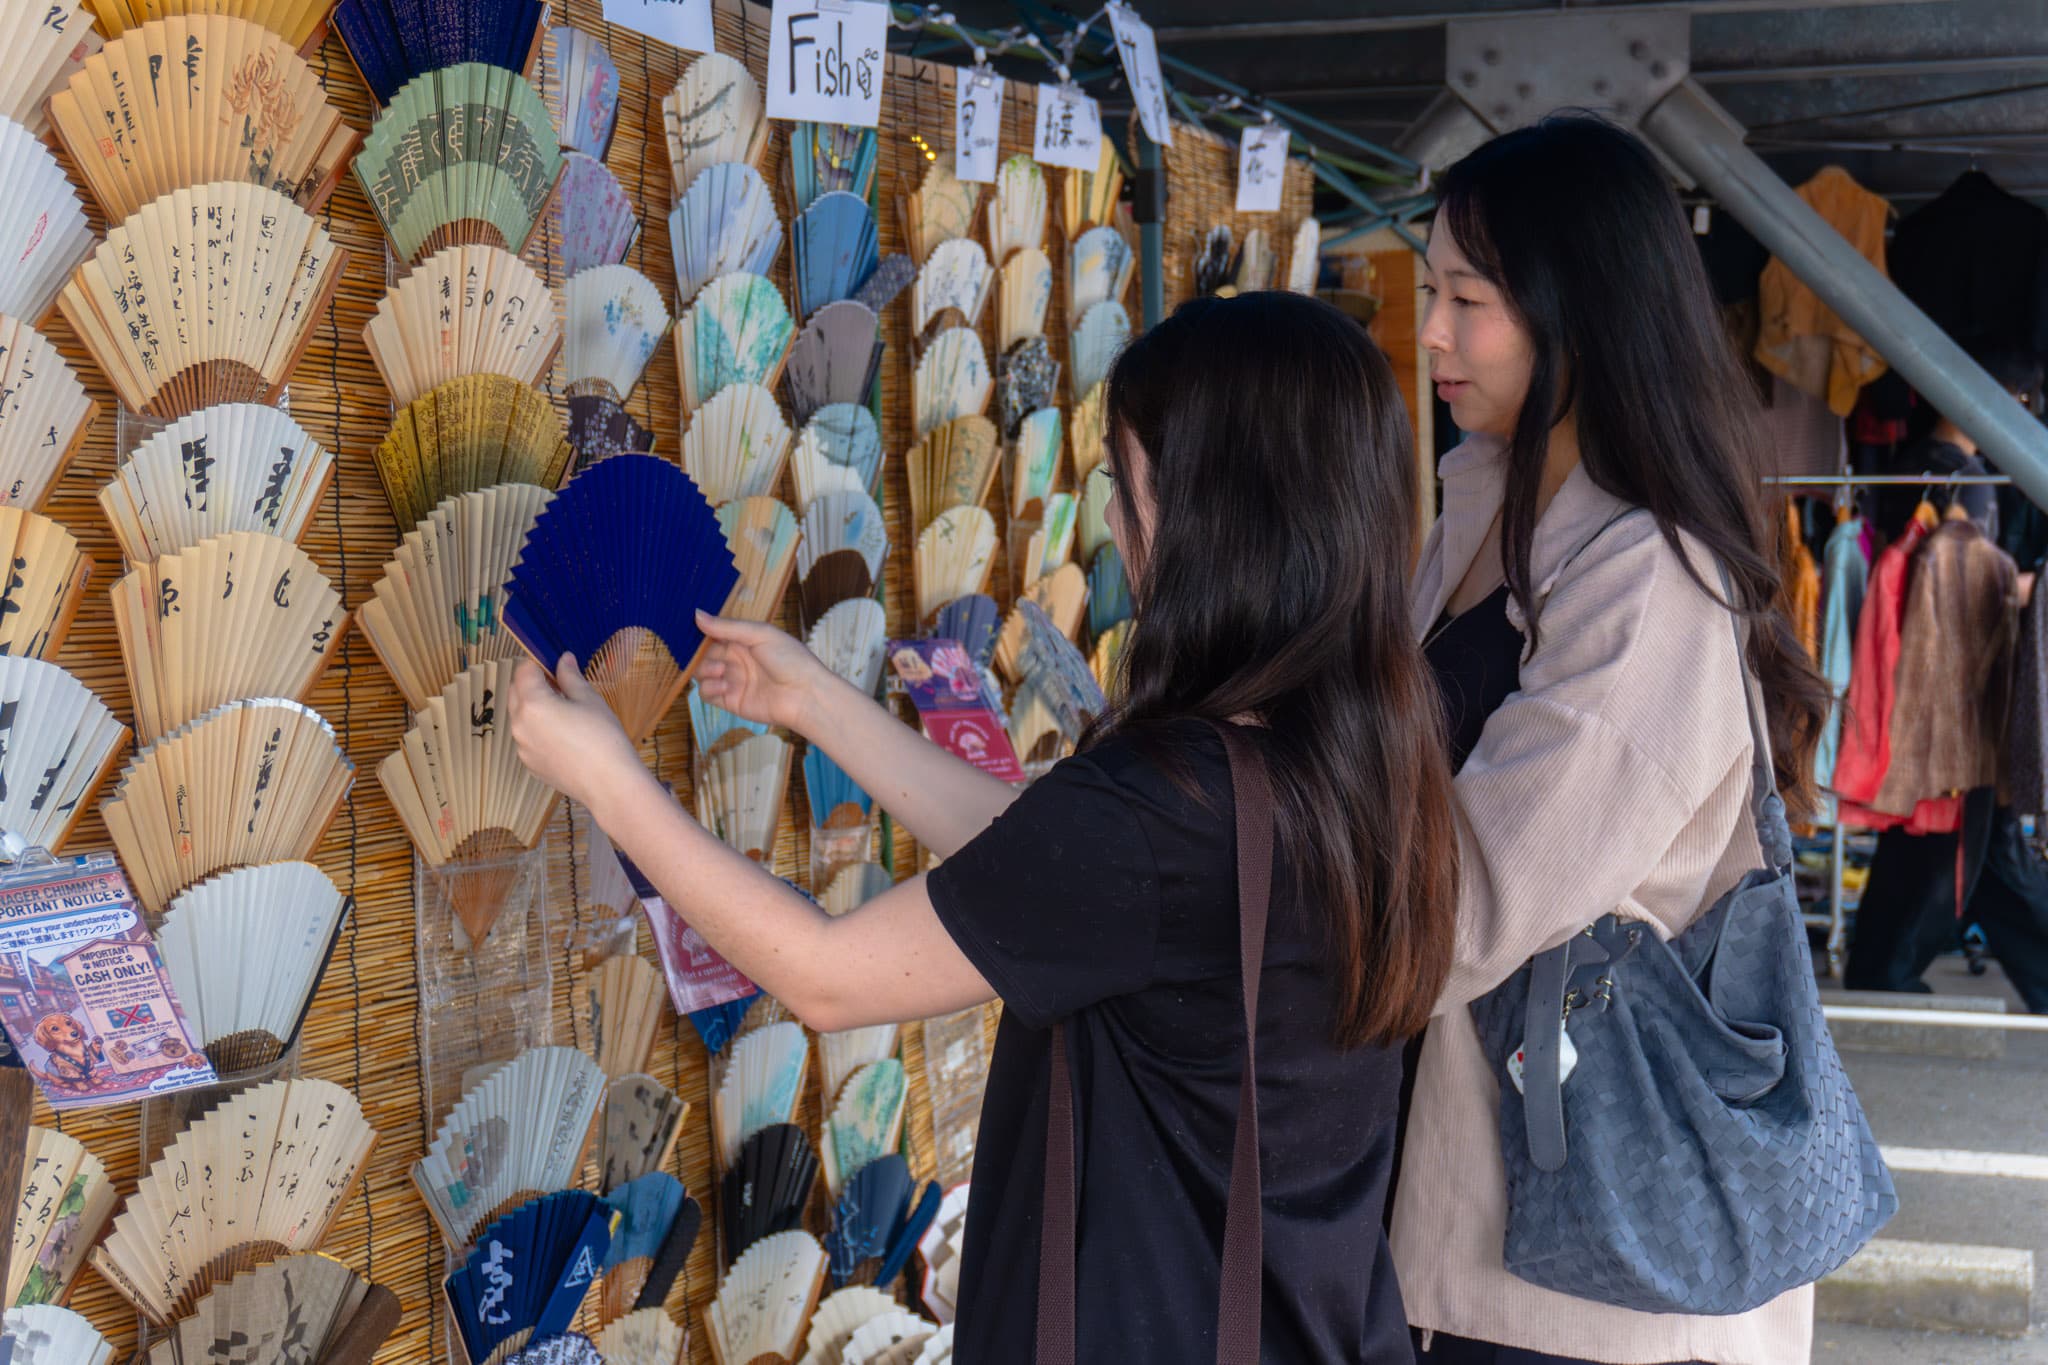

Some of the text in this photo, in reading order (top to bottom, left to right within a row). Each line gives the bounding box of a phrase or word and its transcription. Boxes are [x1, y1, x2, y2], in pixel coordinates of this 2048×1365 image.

[788, 12, 851, 97] Fish
[43, 878, 109, 900] CHIMMY'S
[63, 890, 113, 908] NOTICE
[15, 929, 30, 938] you
[30, 926, 43, 935] for
[44, 924, 61, 935] your
[63, 912, 120, 928] understanding!
[78, 945, 130, 961] IMPORTANT
[91, 955, 125, 969] NOTICE
[75, 961, 152, 986] CASH ONLY!
